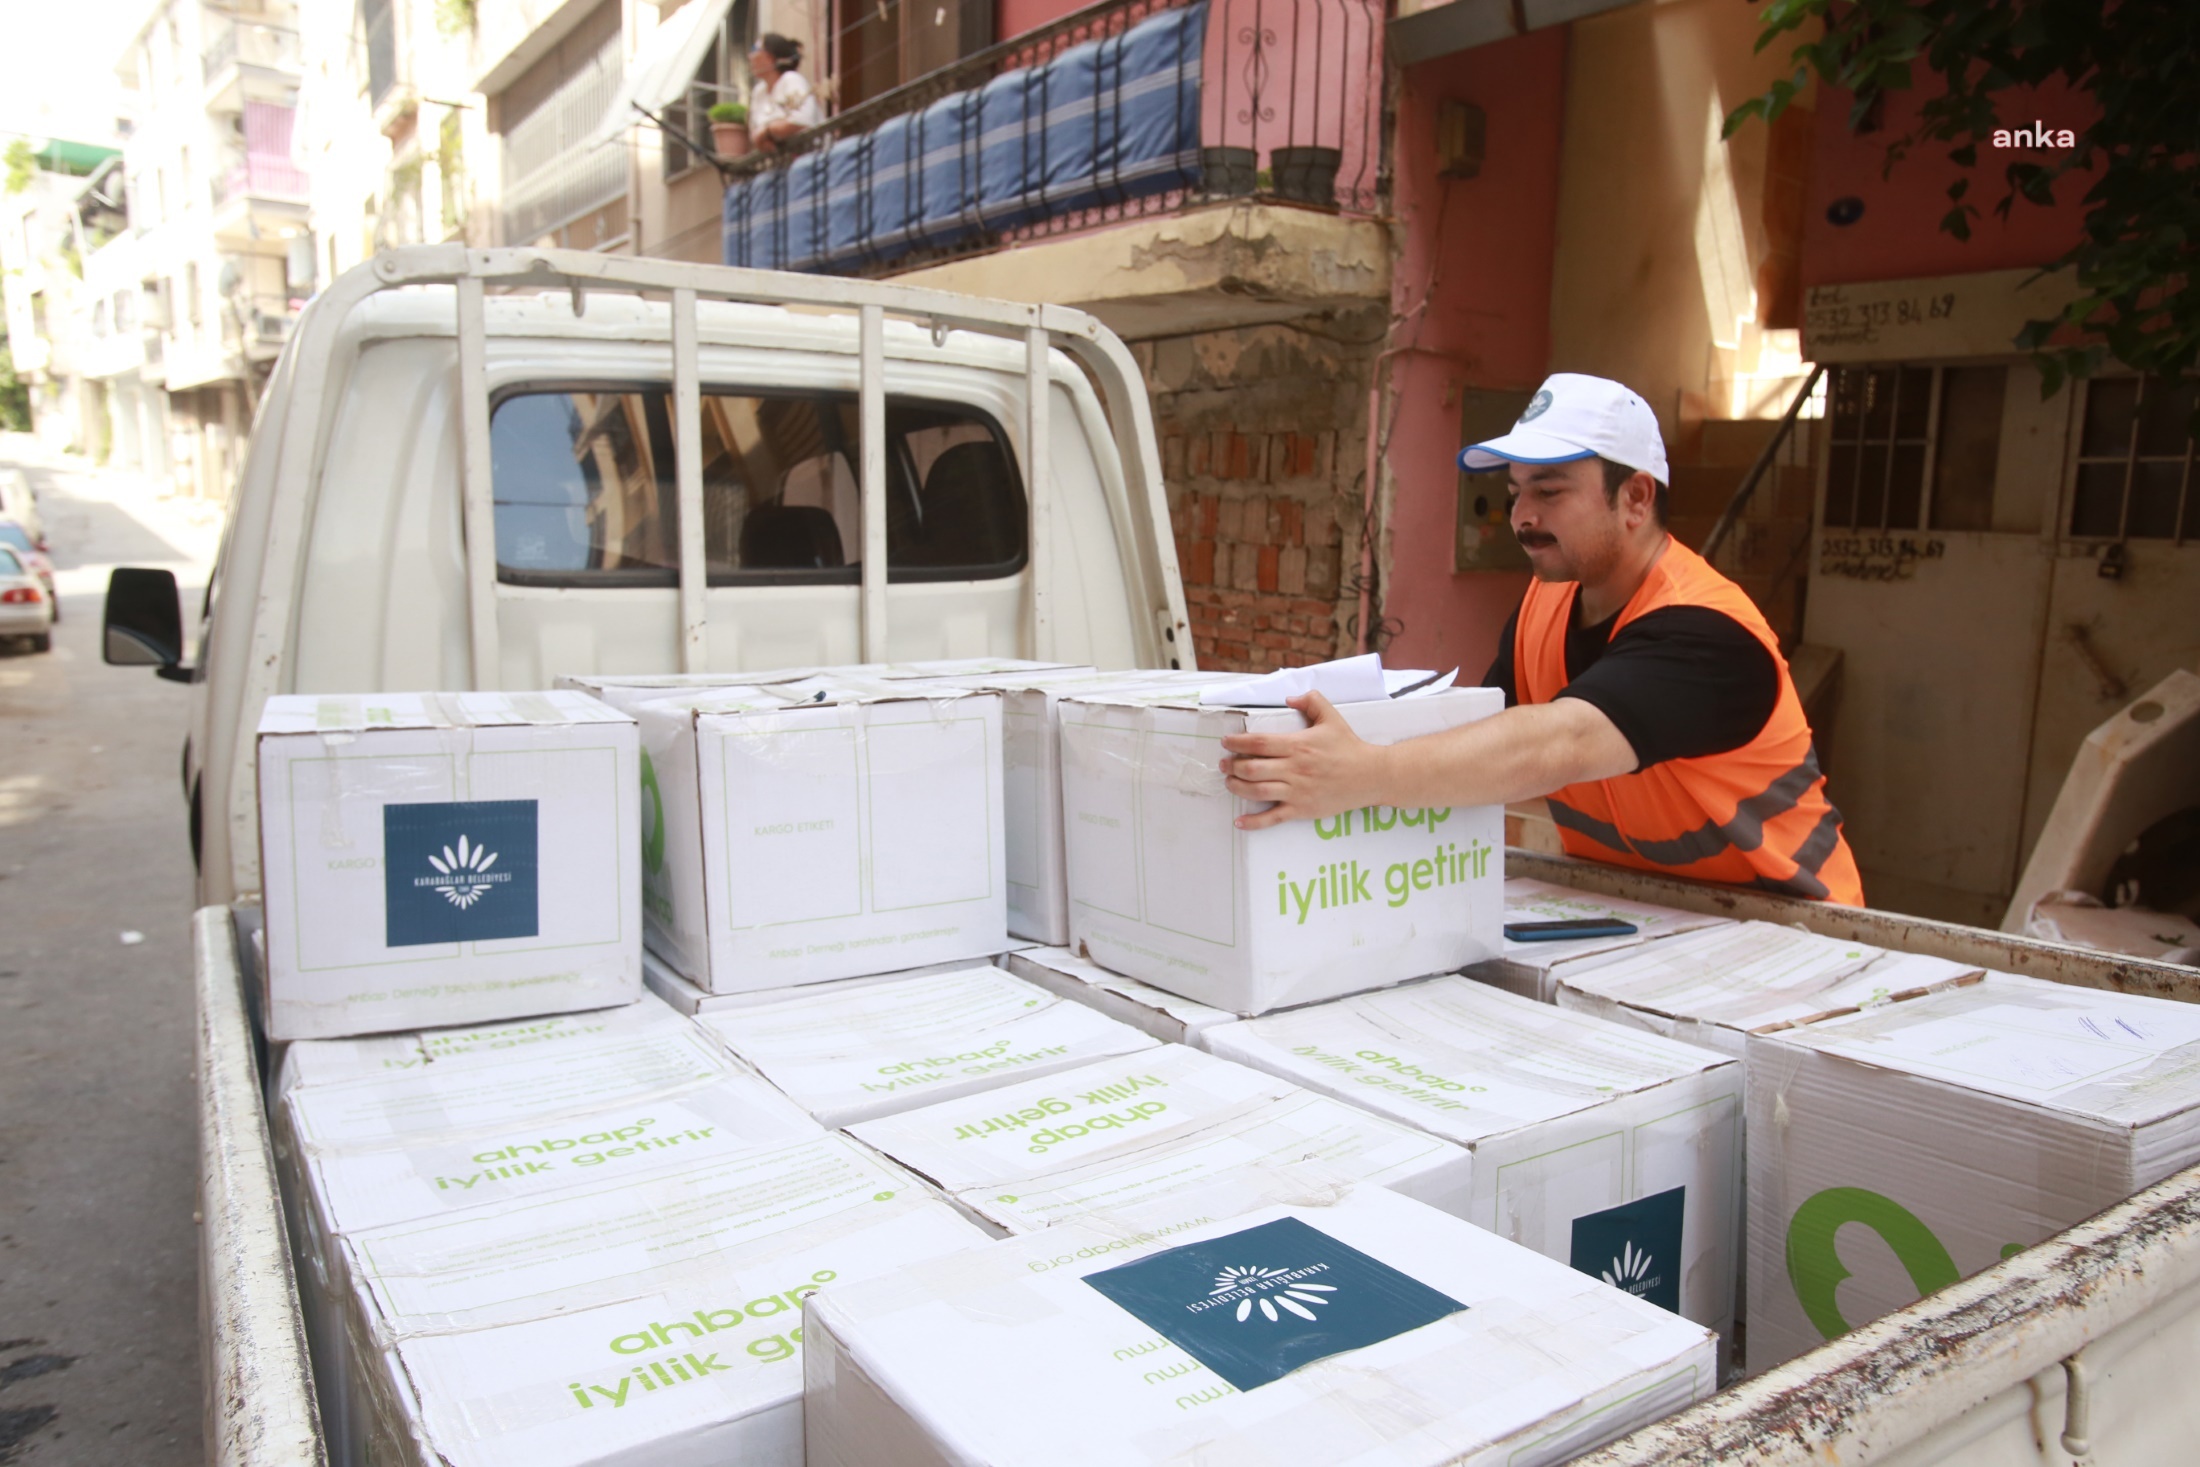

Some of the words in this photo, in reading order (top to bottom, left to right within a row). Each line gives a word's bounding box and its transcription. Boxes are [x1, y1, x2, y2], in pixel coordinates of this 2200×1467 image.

[753, 823, 794, 836] KARGO
[328, 857, 376, 871] KARGO
[1277, 861, 1373, 925] iyilik
[1384, 838, 1492, 909] getirir
[500, 1025, 606, 1050] getirir
[863, 1073, 950, 1092] iyilik
[972, 1044, 1068, 1074] getirir
[876, 1043, 1005, 1076] ahbap
[1355, 1049, 1466, 1092] ahbap
[1075, 1074, 1169, 1106] iyilik
[1292, 1045, 1365, 1075] iyilik
[1355, 1074, 1471, 1112] getirir
[953, 1096, 1073, 1142] getirir
[1030, 1100, 1168, 1146] ahbap
[434, 1159, 556, 1191] iyilik
[570, 1126, 716, 1167] getirir
[472, 1121, 645, 1164] ahbap
[1256, 1262, 1330, 1290] KARABAĞLAR
[1186, 1286, 1256, 1314] BELEDİYESİ
[1113, 1337, 1170, 1362] rmu
[567, 1351, 733, 1410] iyilik
[1143, 1359, 1202, 1385] rmu
[1175, 1382, 1236, 1410] rmu
